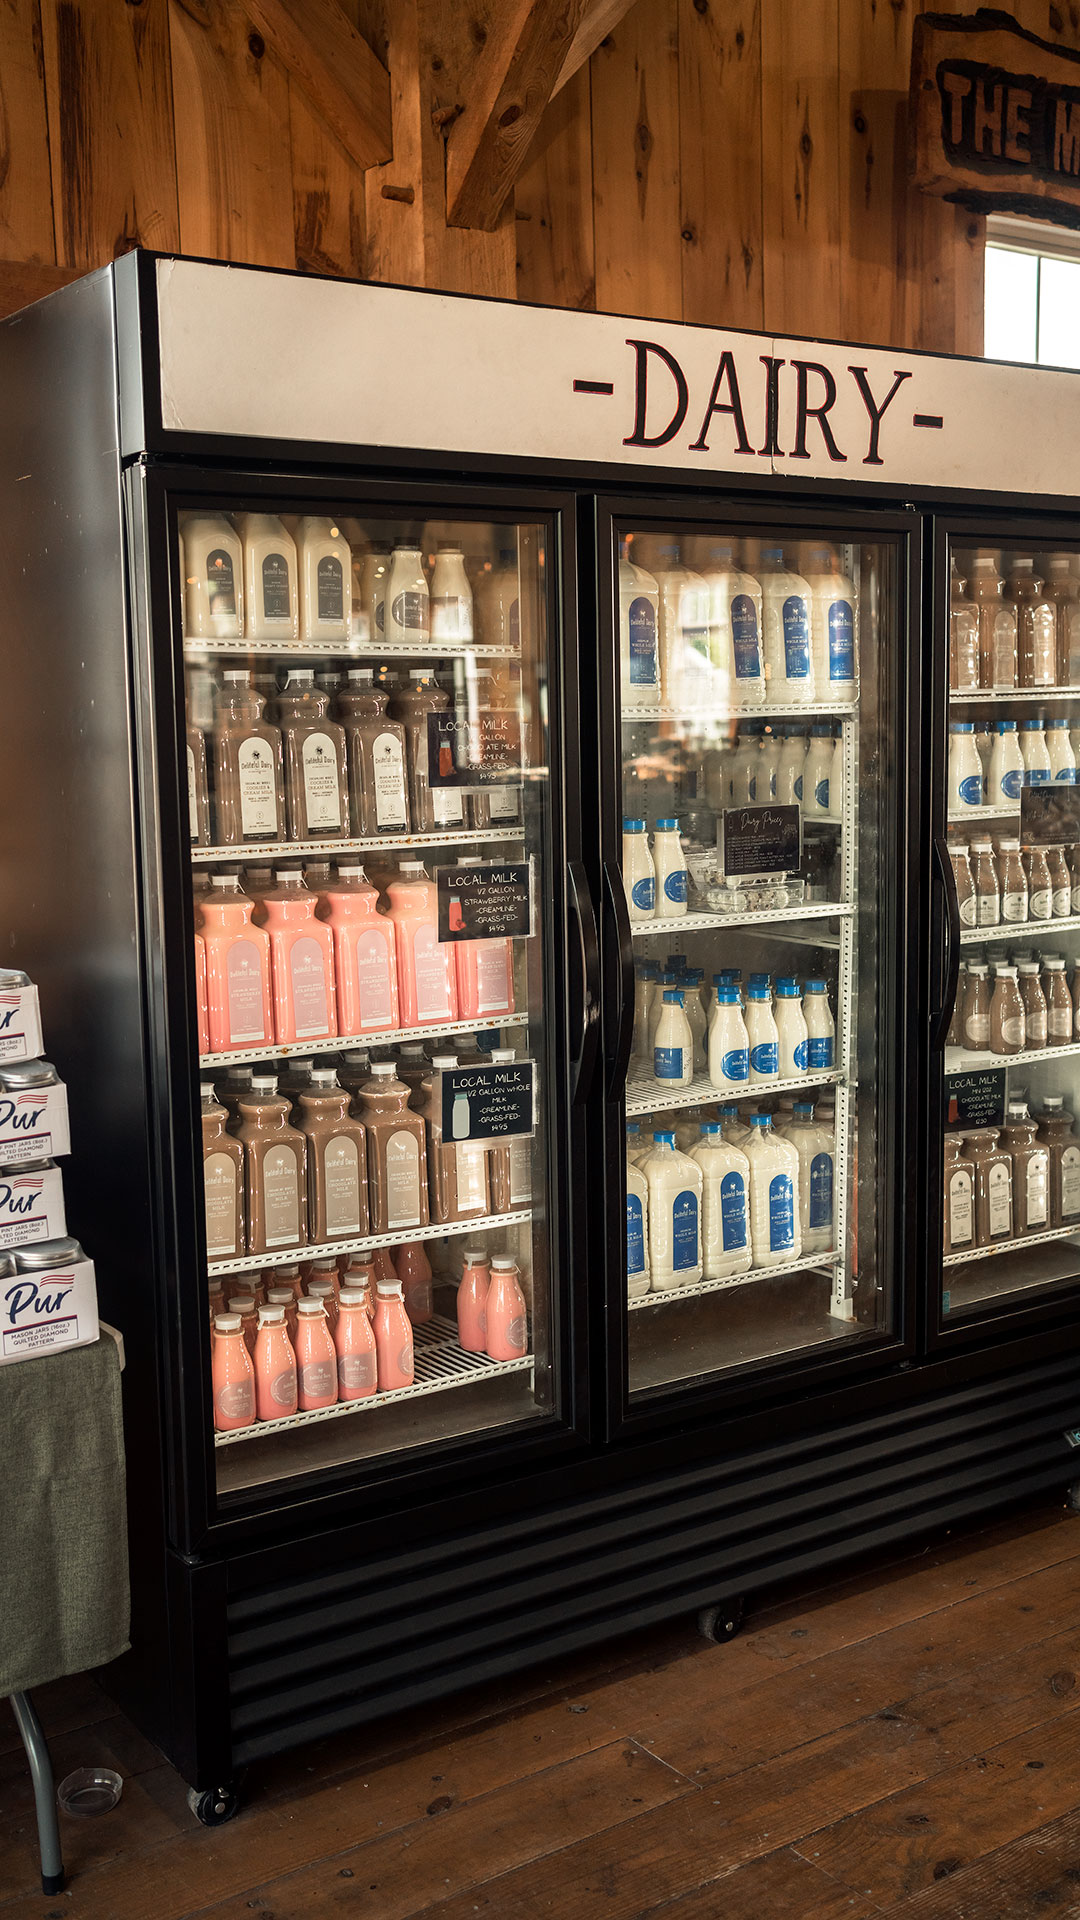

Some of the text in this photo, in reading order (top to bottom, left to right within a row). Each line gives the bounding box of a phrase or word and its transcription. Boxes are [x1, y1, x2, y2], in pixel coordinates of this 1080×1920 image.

[943, 71, 1033, 164] THE
[481, 719, 509, 731] MILK
[448, 872, 518, 887] LOCAL MILK
[487, 885, 515, 894] GALLON
[464, 895, 511, 906] STRAWBERRY
[452, 1072, 521, 1089] LOCAL MILK
[949, 1075, 998, 1089] LOCAL MILK
[478, 1087, 505, 1096] GALLON
[506, 1083, 531, 1093] WHOLE
[19, 1144, 44, 1153] DIAMOND
[7, 1151, 31, 1160] PATTERN
[14, 1227, 40, 1237] DIAMOND
[4, 1235, 28, 1244] PATTERN
[4, 1282, 73, 1325] Pur
[11, 1329, 34, 1340] MASON
[34, 1326, 50, 1335] JARS
[13, 1328, 69, 1346] QUILTED DIAMOND
[28, 1338, 55, 1348] PATTERN
